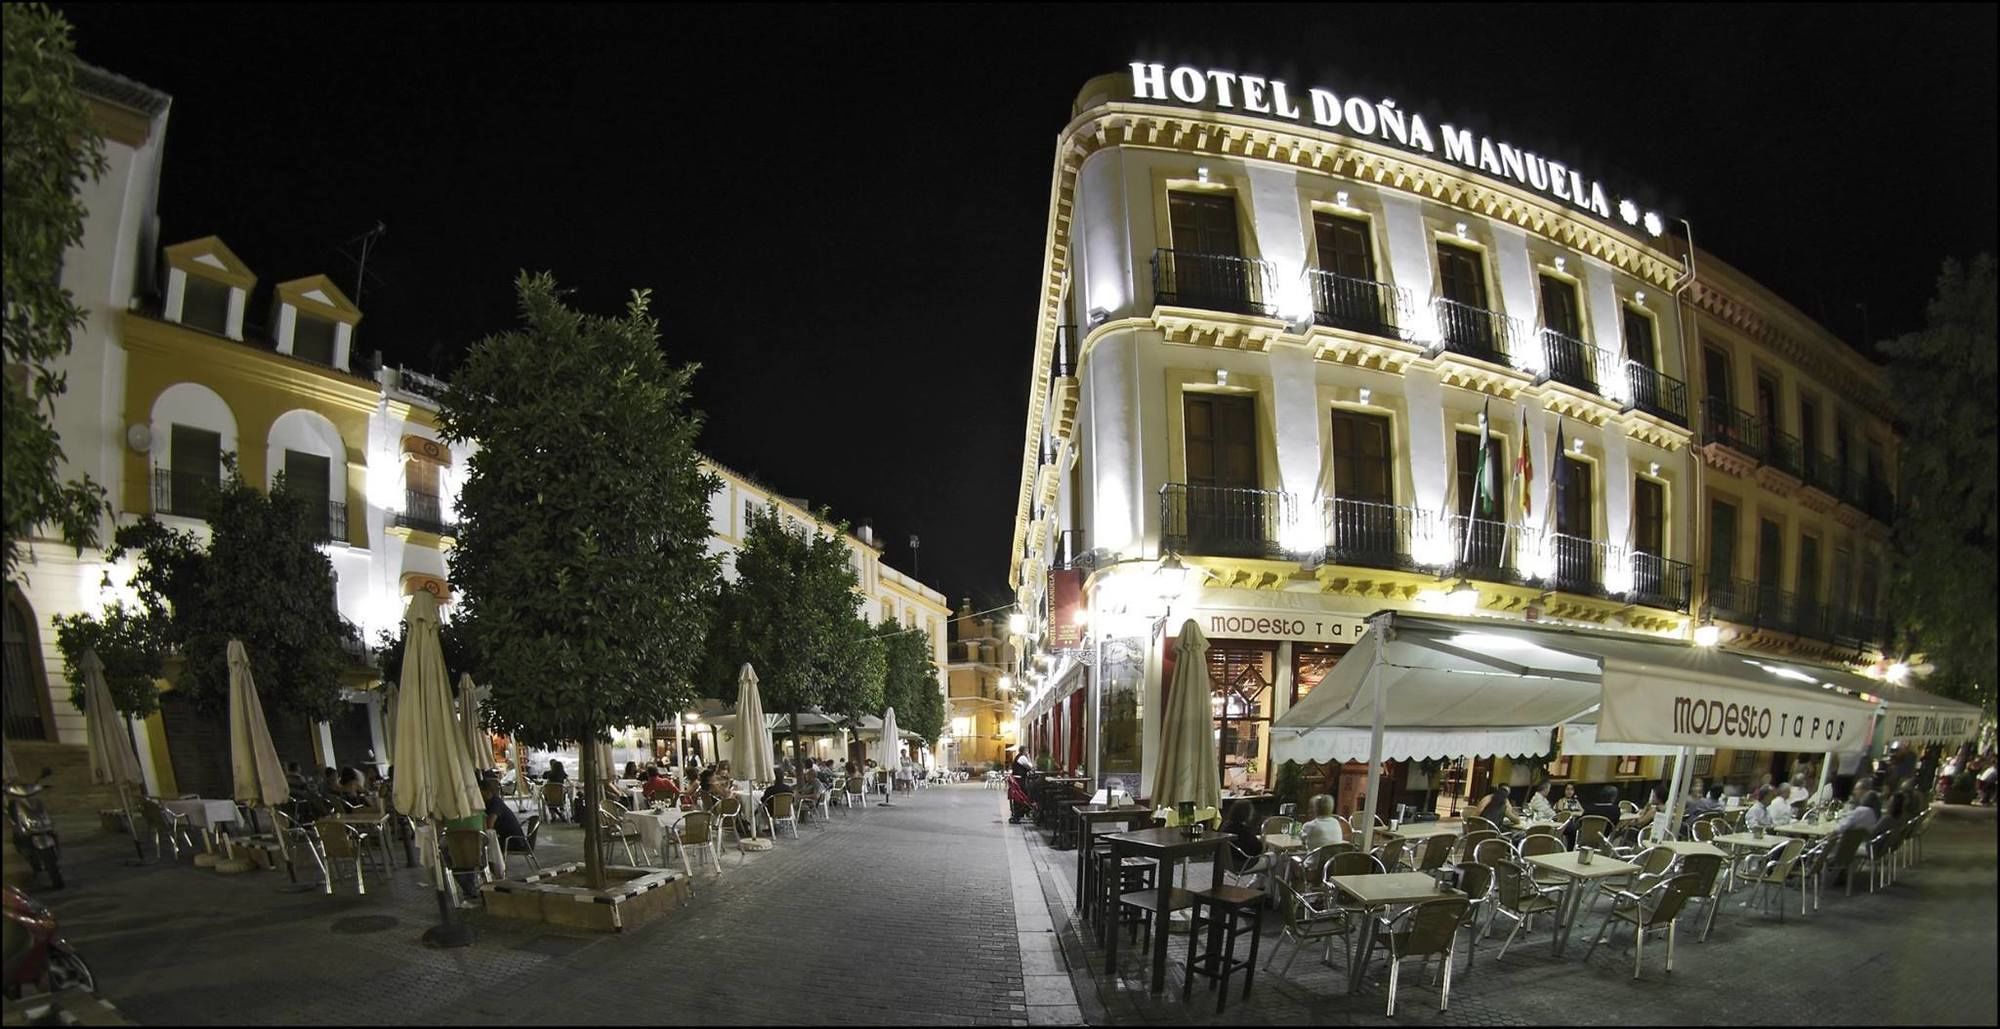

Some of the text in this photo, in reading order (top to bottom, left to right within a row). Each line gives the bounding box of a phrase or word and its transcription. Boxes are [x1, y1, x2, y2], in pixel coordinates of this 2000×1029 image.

[1128, 61, 1610, 219] HOTEL DOÑA MANUELA
